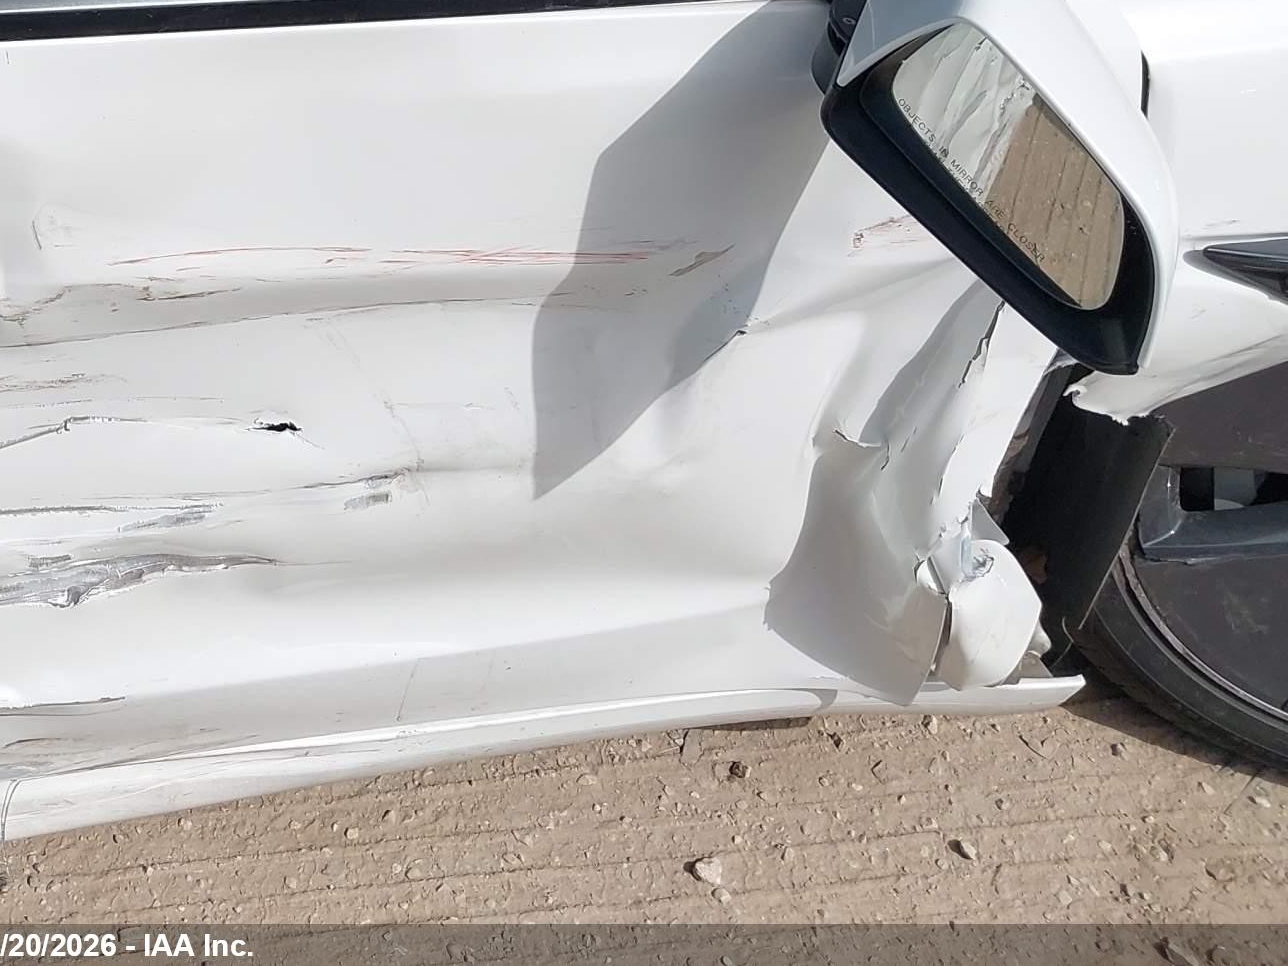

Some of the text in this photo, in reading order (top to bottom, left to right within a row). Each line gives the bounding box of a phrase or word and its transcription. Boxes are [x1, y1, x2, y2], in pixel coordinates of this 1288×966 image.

[897, 97, 937, 143] OBJECTS
[938, 145, 950, 159] IN
[950, 158, 985, 197] MIRROR
[984, 199, 1007, 220] ARE
[1006, 221, 1047, 264] CLOSER
